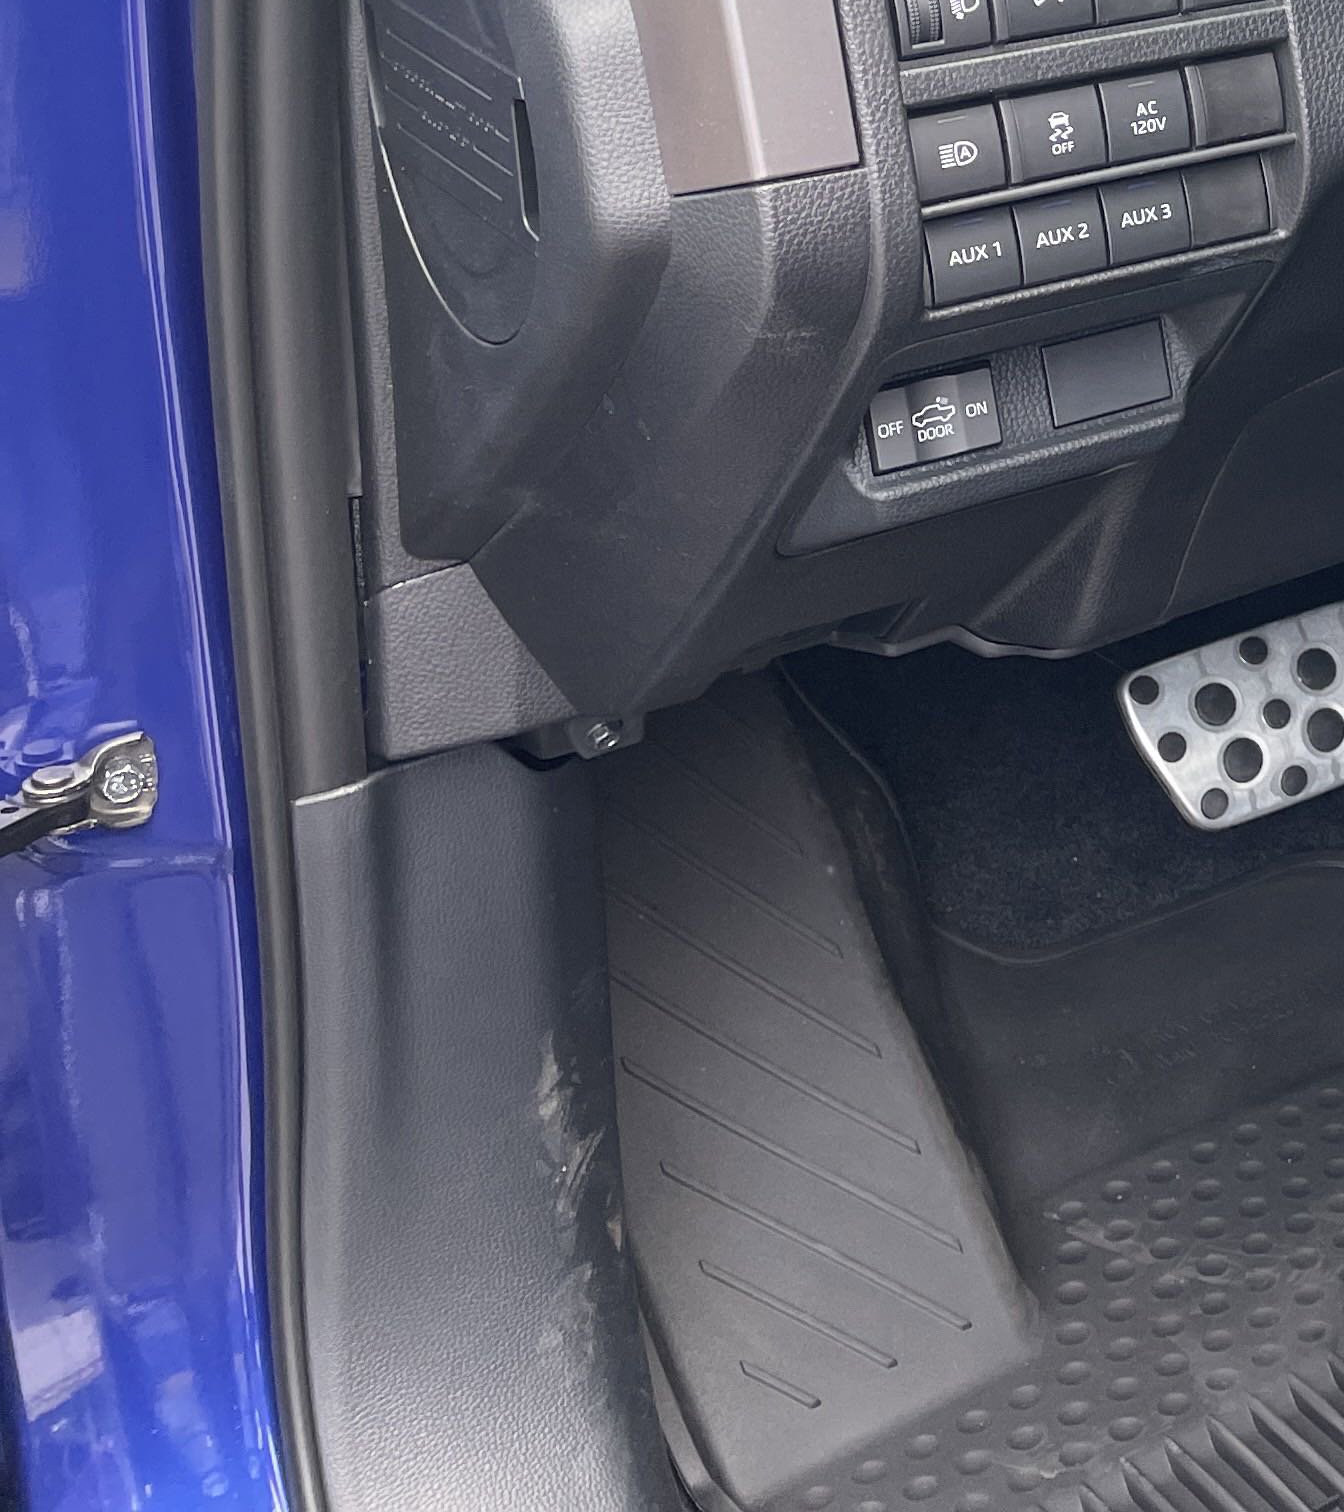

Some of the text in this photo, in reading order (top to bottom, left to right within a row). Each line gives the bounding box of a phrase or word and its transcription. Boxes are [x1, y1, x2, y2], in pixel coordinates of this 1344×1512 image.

[1135, 100, 1159, 118] AC
[1130, 116, 1168, 137] 120V
[1051, 139, 1076, 156] OFF
[1120, 203, 1173, 229] AUX 3
[1035, 222, 1090, 249] AUX 2
[949, 241, 1003, 267] AUX 1
[965, 400, 989, 418] ON
[877, 420, 905, 440] OFF
[917, 423, 955, 443] DOOR
